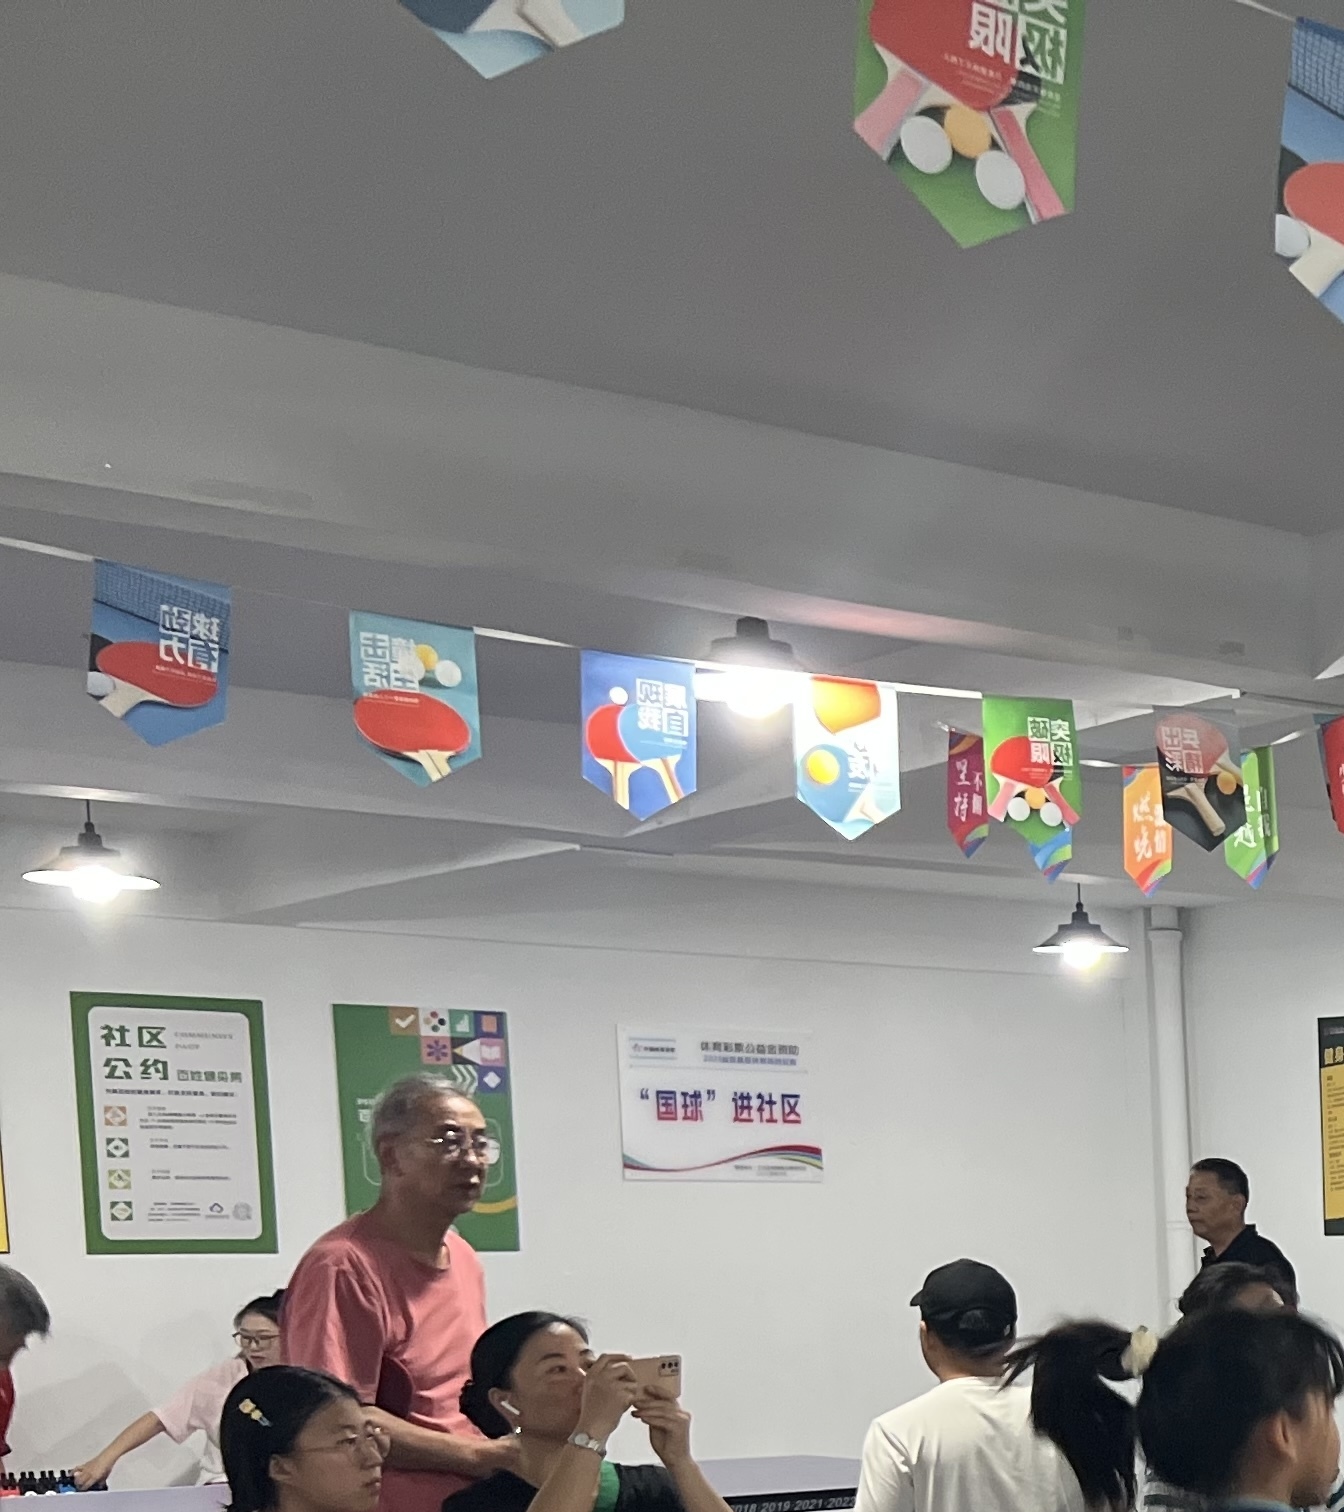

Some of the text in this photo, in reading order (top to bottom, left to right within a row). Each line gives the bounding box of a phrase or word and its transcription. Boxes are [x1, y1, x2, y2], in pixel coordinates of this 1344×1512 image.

[99, 1023, 168, 1049] 社区
[102, 1056, 170, 1082] 公约
[639, 1087, 803, 1125] “国球” 进社区
